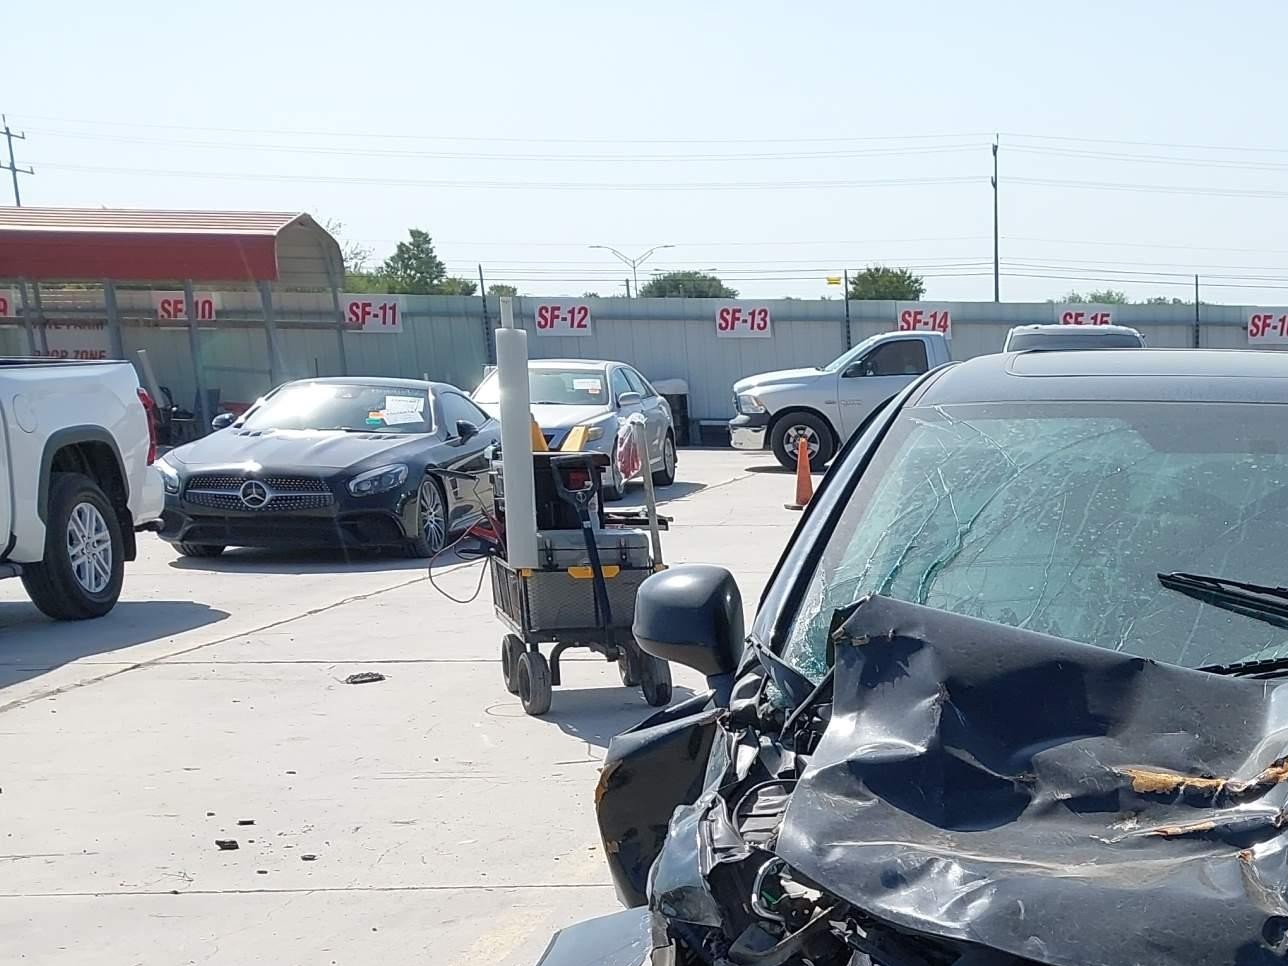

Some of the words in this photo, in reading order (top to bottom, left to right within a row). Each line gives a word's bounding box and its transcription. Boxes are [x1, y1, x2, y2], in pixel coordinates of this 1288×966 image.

[160, 299, 214, 319] SF10
[348, 302, 397, 325] SF-11
[537, 305, 588, 329] SF-12
[718, 307, 768, 331] SF-13
[900, 310, 949, 332] SF-14
